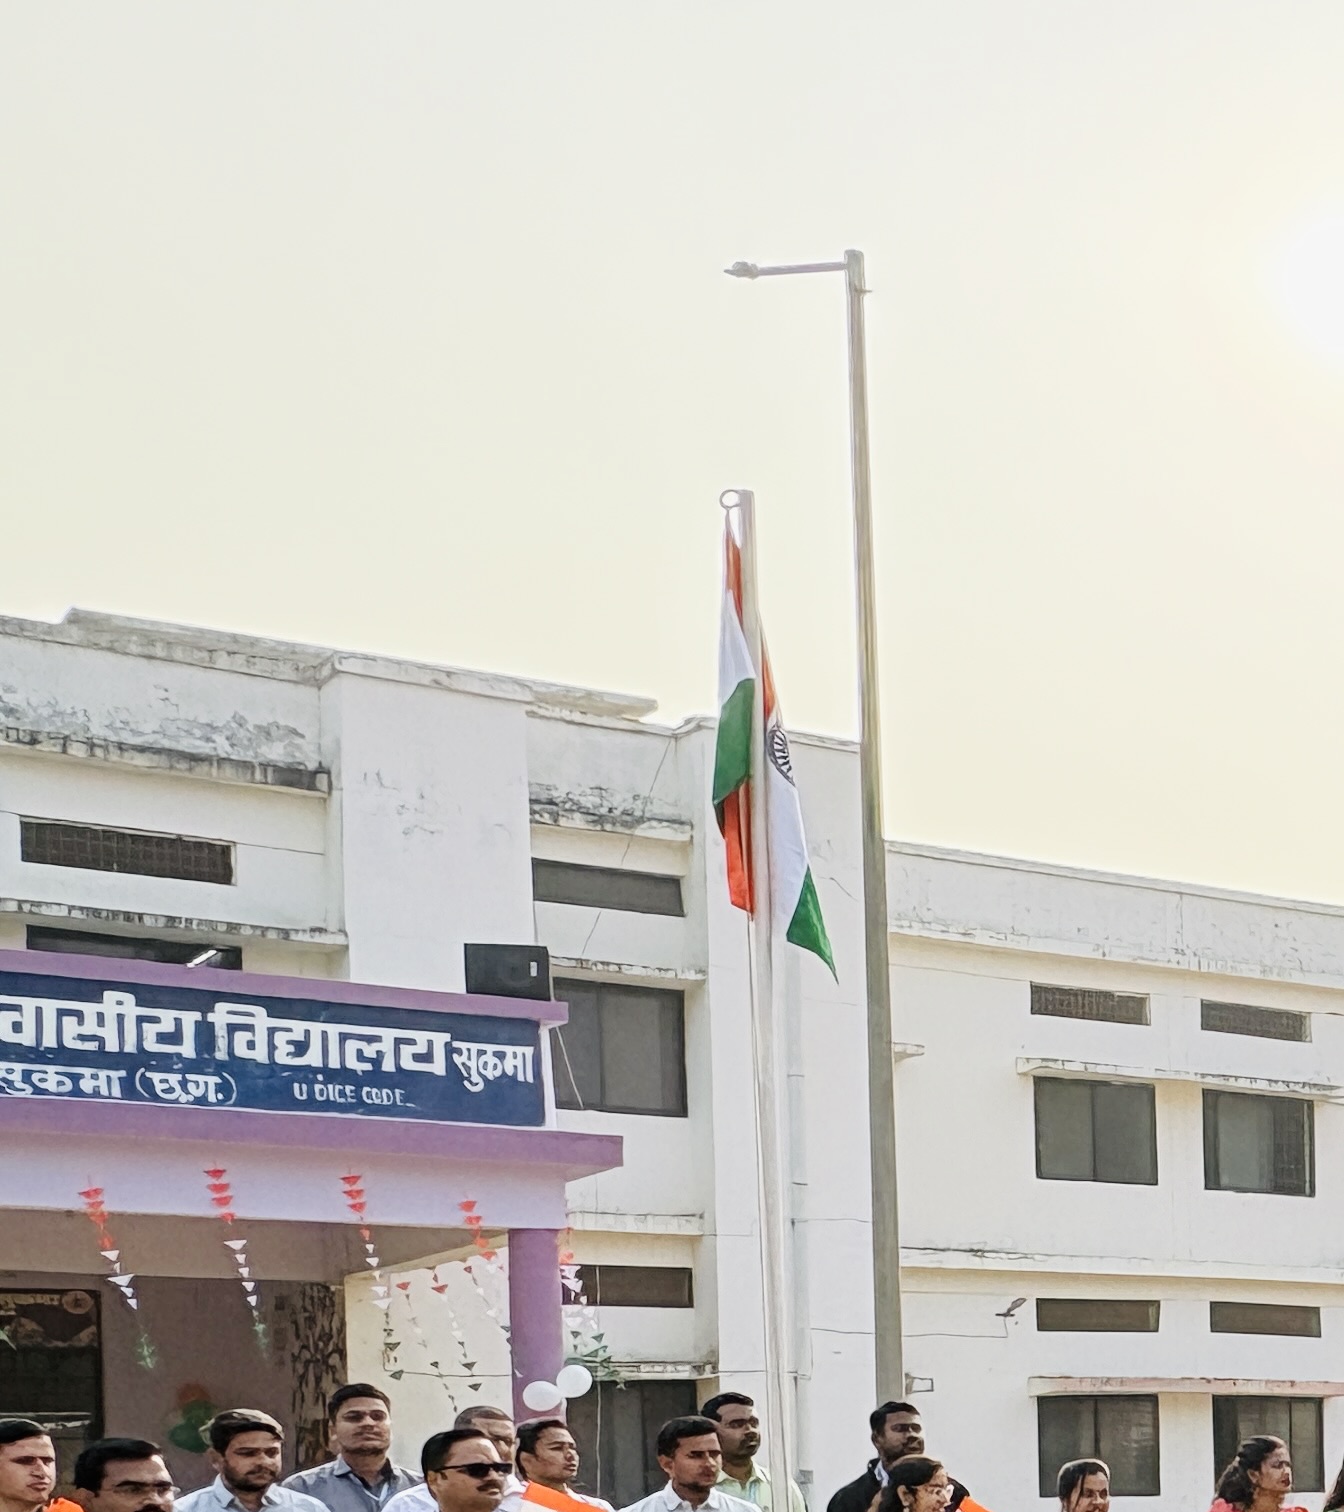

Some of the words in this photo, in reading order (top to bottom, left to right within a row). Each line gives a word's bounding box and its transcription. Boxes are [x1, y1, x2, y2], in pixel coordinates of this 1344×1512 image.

[207, 1002, 451, 1076] विद्यालय
[451, 1040, 535, 1093] सुकमा
[293, 1082, 308, 1101] U
[314, 1083, 357, 1103] DICE
